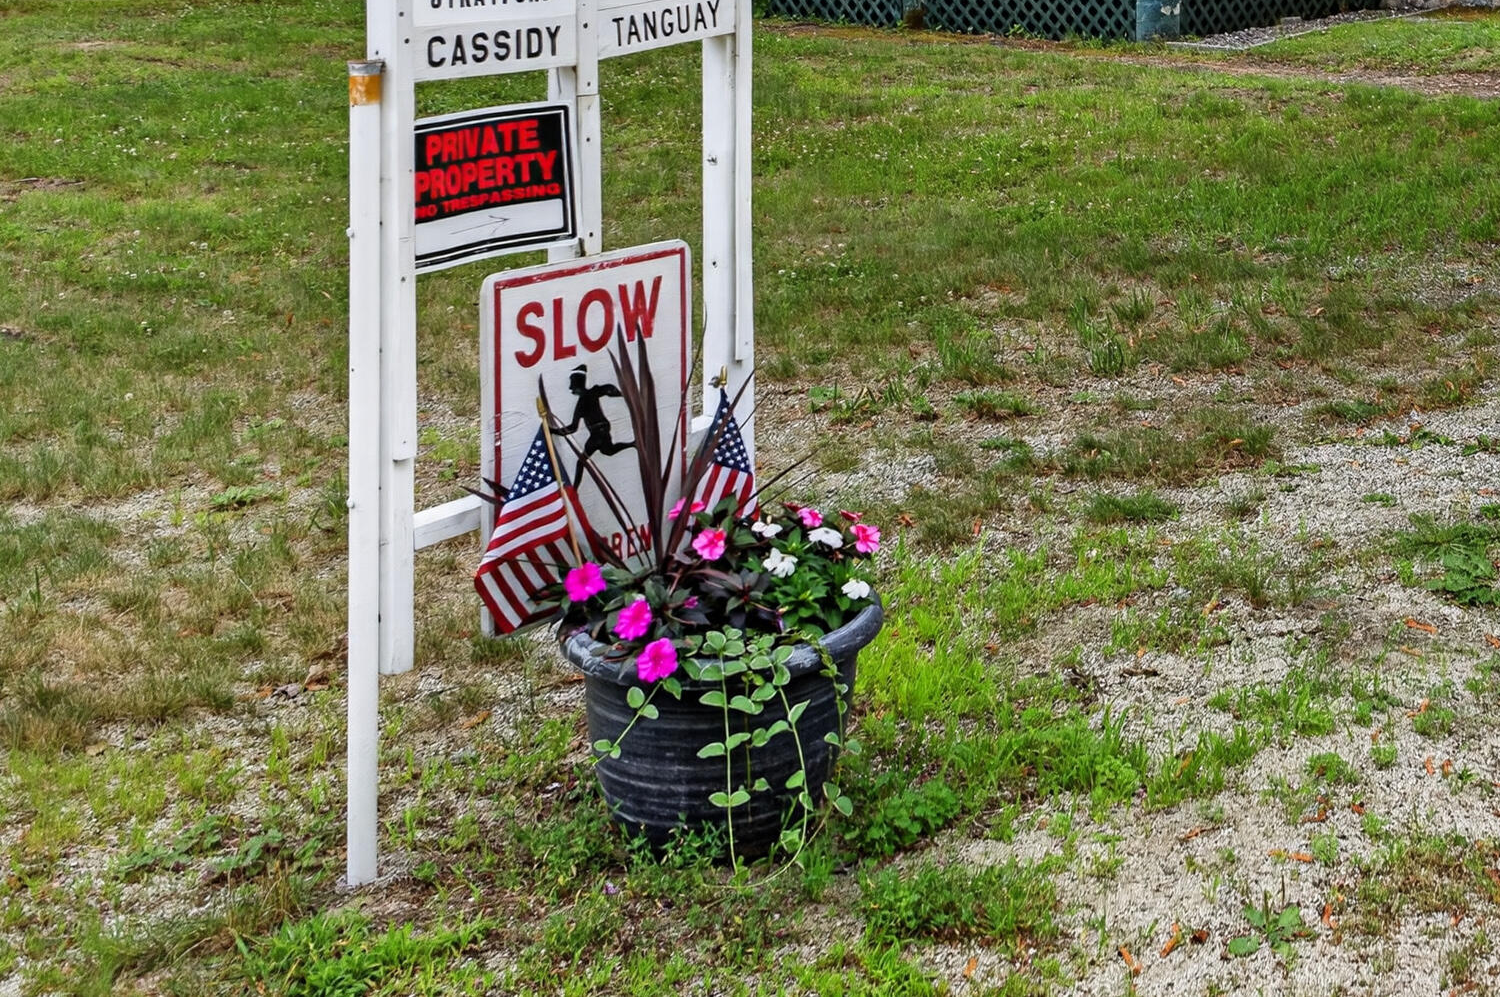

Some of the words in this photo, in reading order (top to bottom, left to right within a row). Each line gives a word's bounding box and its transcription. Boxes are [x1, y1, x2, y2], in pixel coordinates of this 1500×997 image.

[427, 25, 561, 68] CASSIDY
[611, 0, 721, 47] TANGUAY
[425, 119, 540, 166] PRIVATE
[414, 149, 557, 202] PROPERTY
[414, 204, 437, 219] NO
[441, 183, 561, 213] TRESPASSING
[514, 275, 663, 368] SLOW
